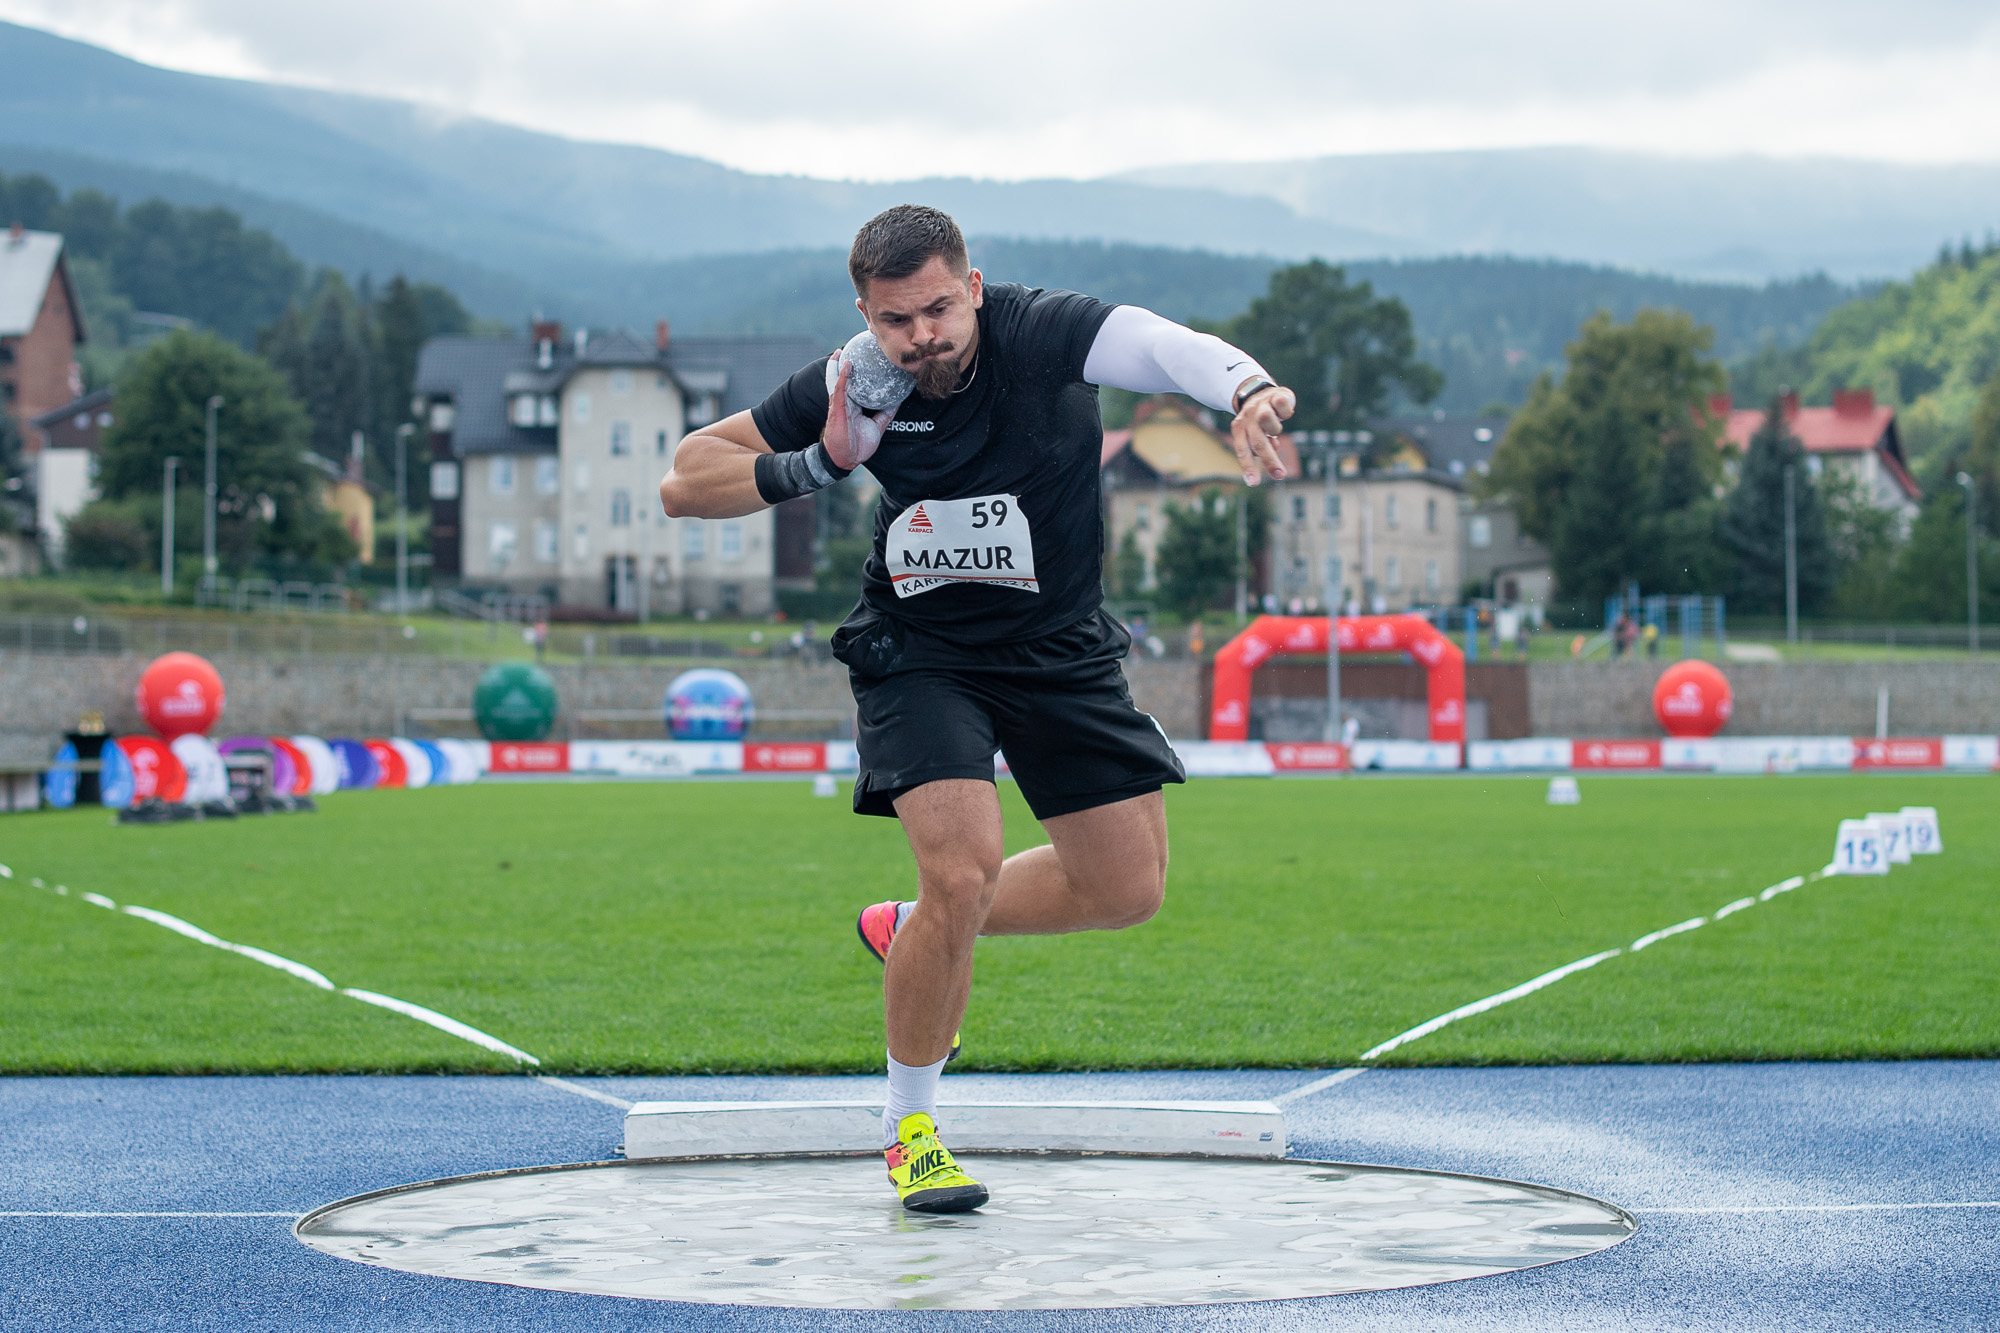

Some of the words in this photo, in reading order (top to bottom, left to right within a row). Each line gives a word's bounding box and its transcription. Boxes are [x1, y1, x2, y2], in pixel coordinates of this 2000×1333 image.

[971, 499, 1008, 529] 59
[902, 545, 1016, 570] MAZUR
[1885, 829, 1900, 855] 7
[1904, 822, 1933, 850] 19
[1842, 838, 1879, 868] 15
[911, 1130, 923, 1140] NIKE
[909, 1149, 946, 1182] NIKE
